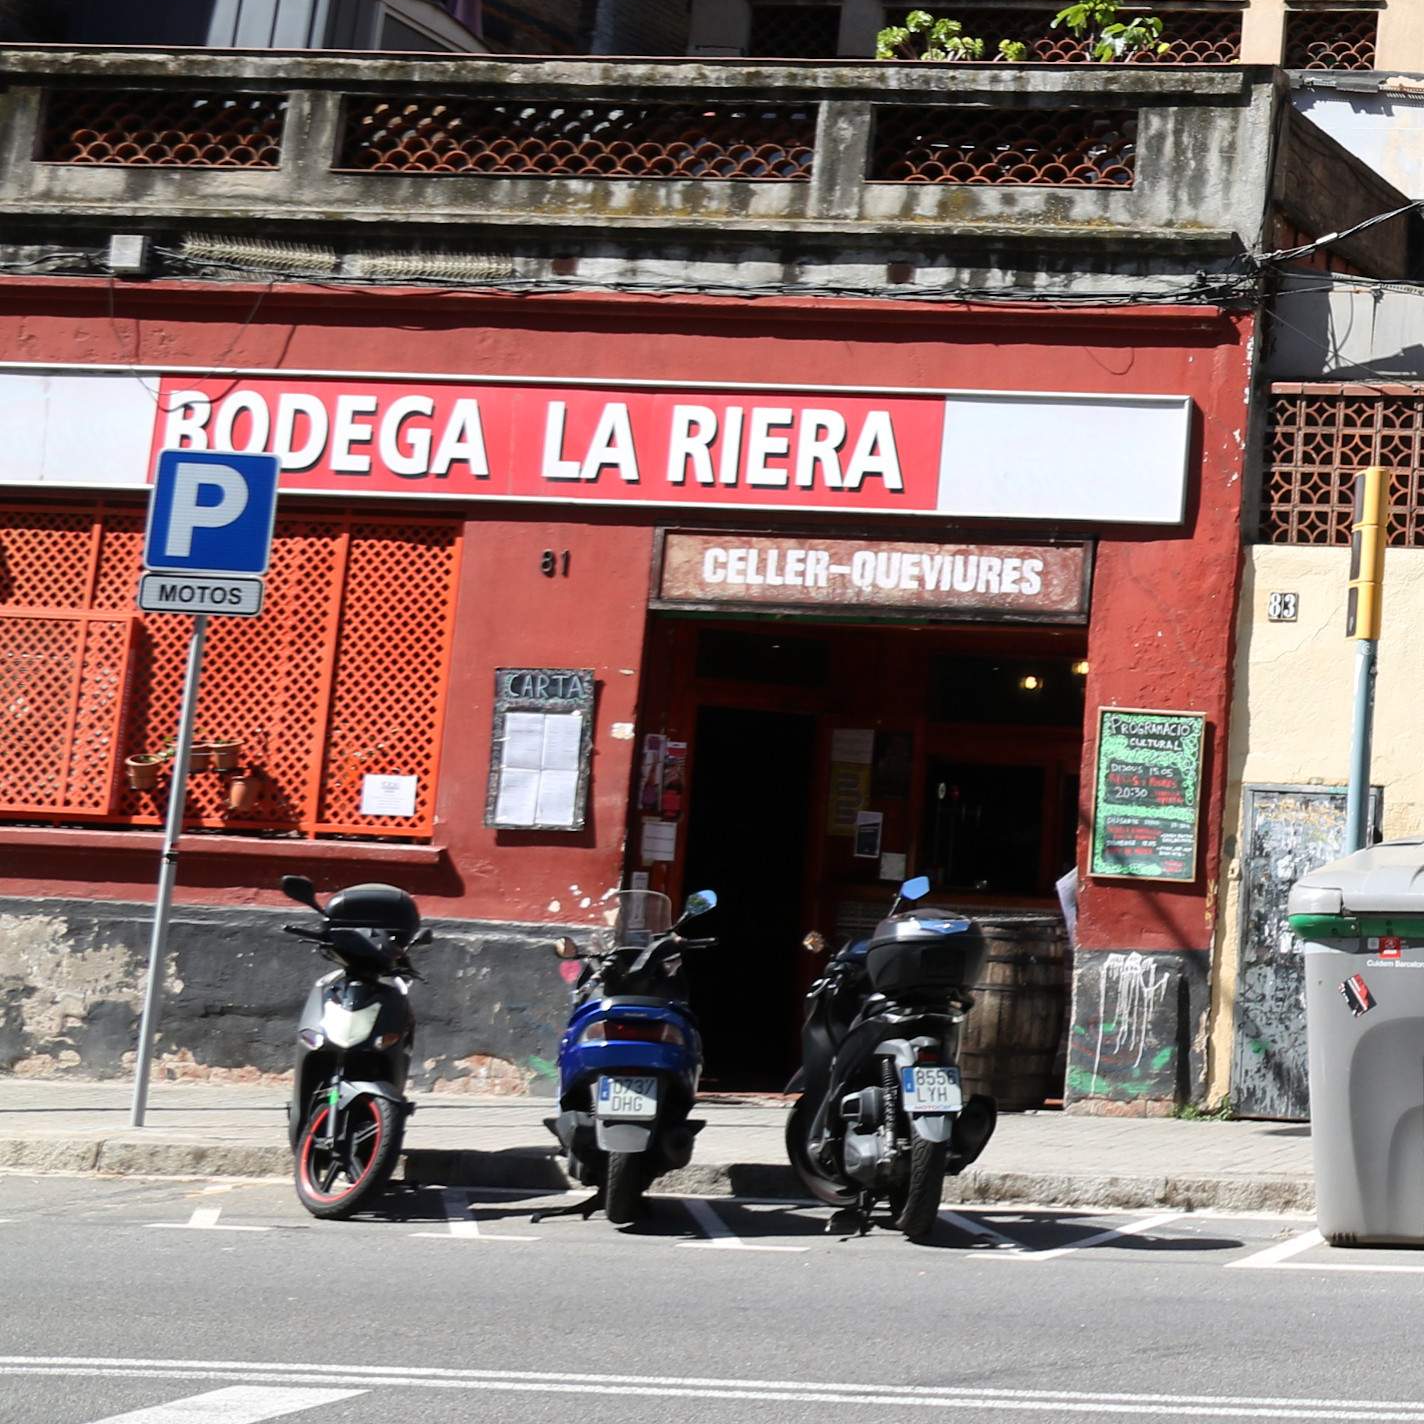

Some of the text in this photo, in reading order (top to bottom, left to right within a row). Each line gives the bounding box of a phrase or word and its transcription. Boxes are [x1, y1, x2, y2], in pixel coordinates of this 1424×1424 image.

[163, 389, 905, 493] BODEGA LA RIERA
[164, 461, 249, 558] P
[541, 548, 571, 579] 81
[702, 547, 1044, 596] CELLER-QUEVIURES
[158, 583, 243, 606] MOTOS
[1268, 592, 1297, 619] 83
[507, 673, 587, 699] CARTA
[1129, 738, 1182, 750] CULTURAL
[1114, 787, 1148, 799] 20:30
[1366, 959, 1394, 968] Cuidem
[611, 1096, 644, 1112] DHG
[917, 1086, 948, 1103] LYH
